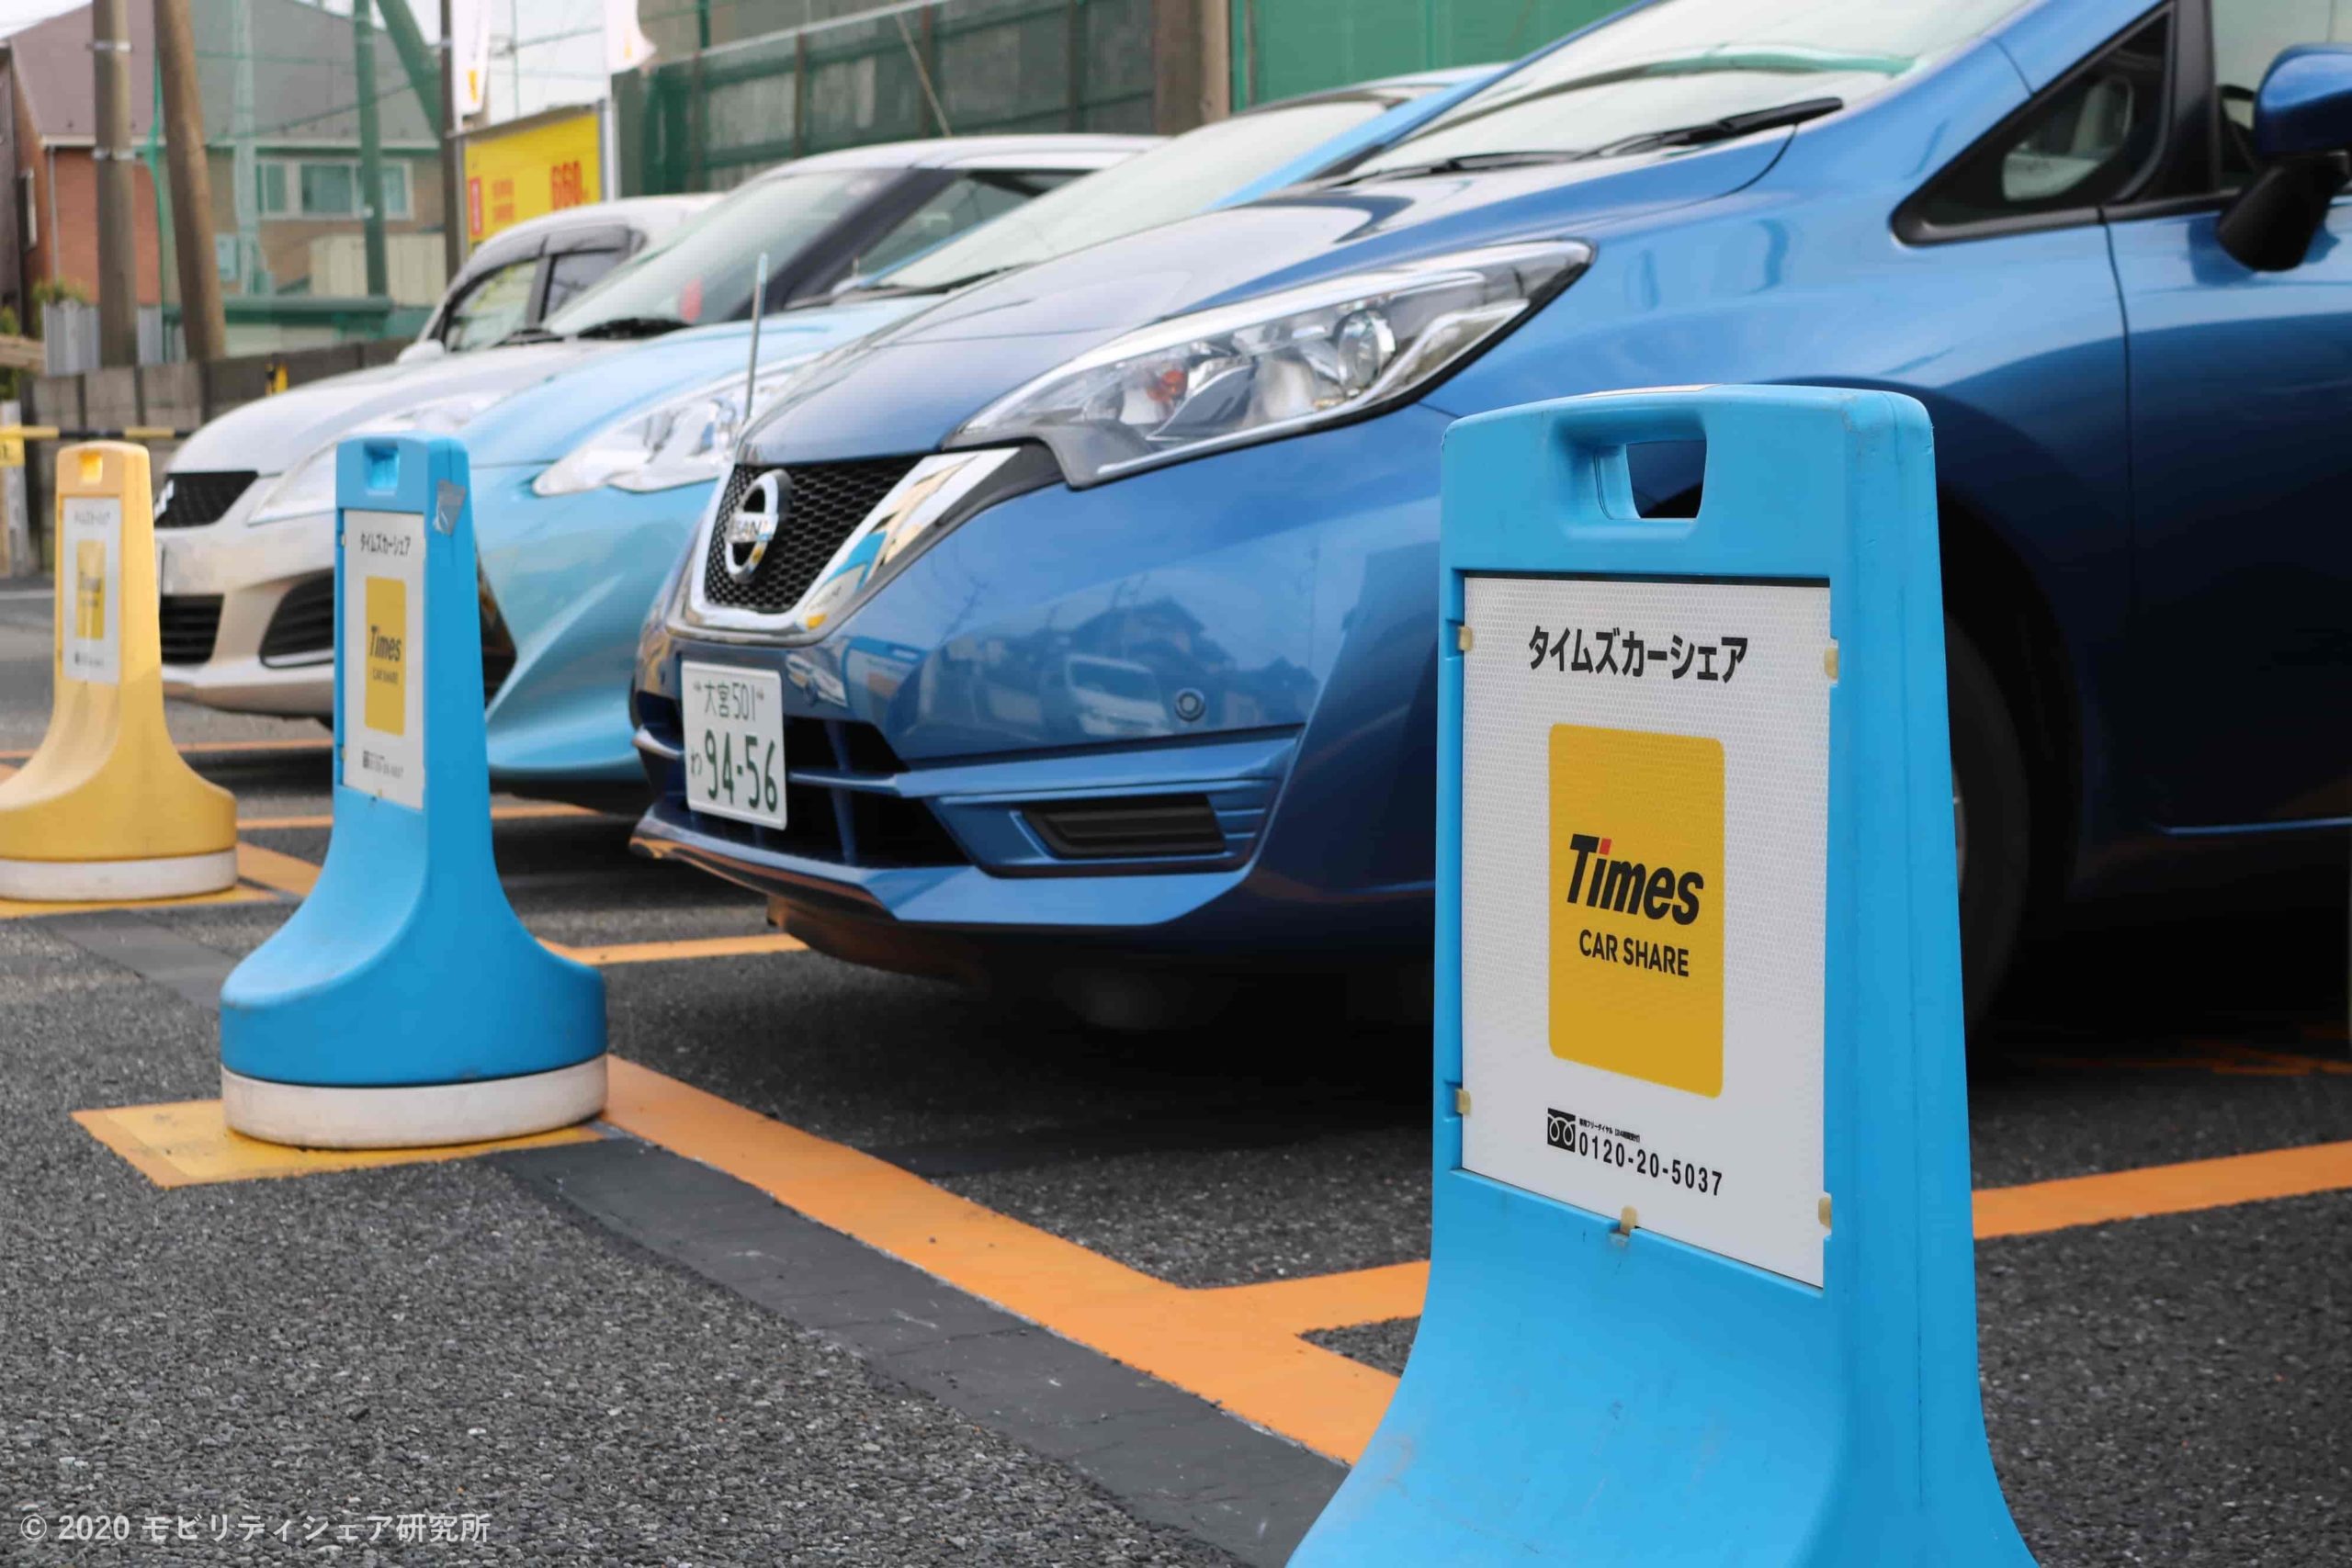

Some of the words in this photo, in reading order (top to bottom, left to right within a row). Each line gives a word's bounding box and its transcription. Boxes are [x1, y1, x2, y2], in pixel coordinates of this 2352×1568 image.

[369, 625, 401, 661] Times
[1529, 626, 1748, 683] タイムズカーシェア
[705, 728, 778, 812] 94-56
[1566, 833, 1704, 925] Times
[1578, 929, 1618, 963] CAR
[1623, 939, 1690, 977] SHARE
[1579, 1132, 1722, 1196] 0120-20-5037
